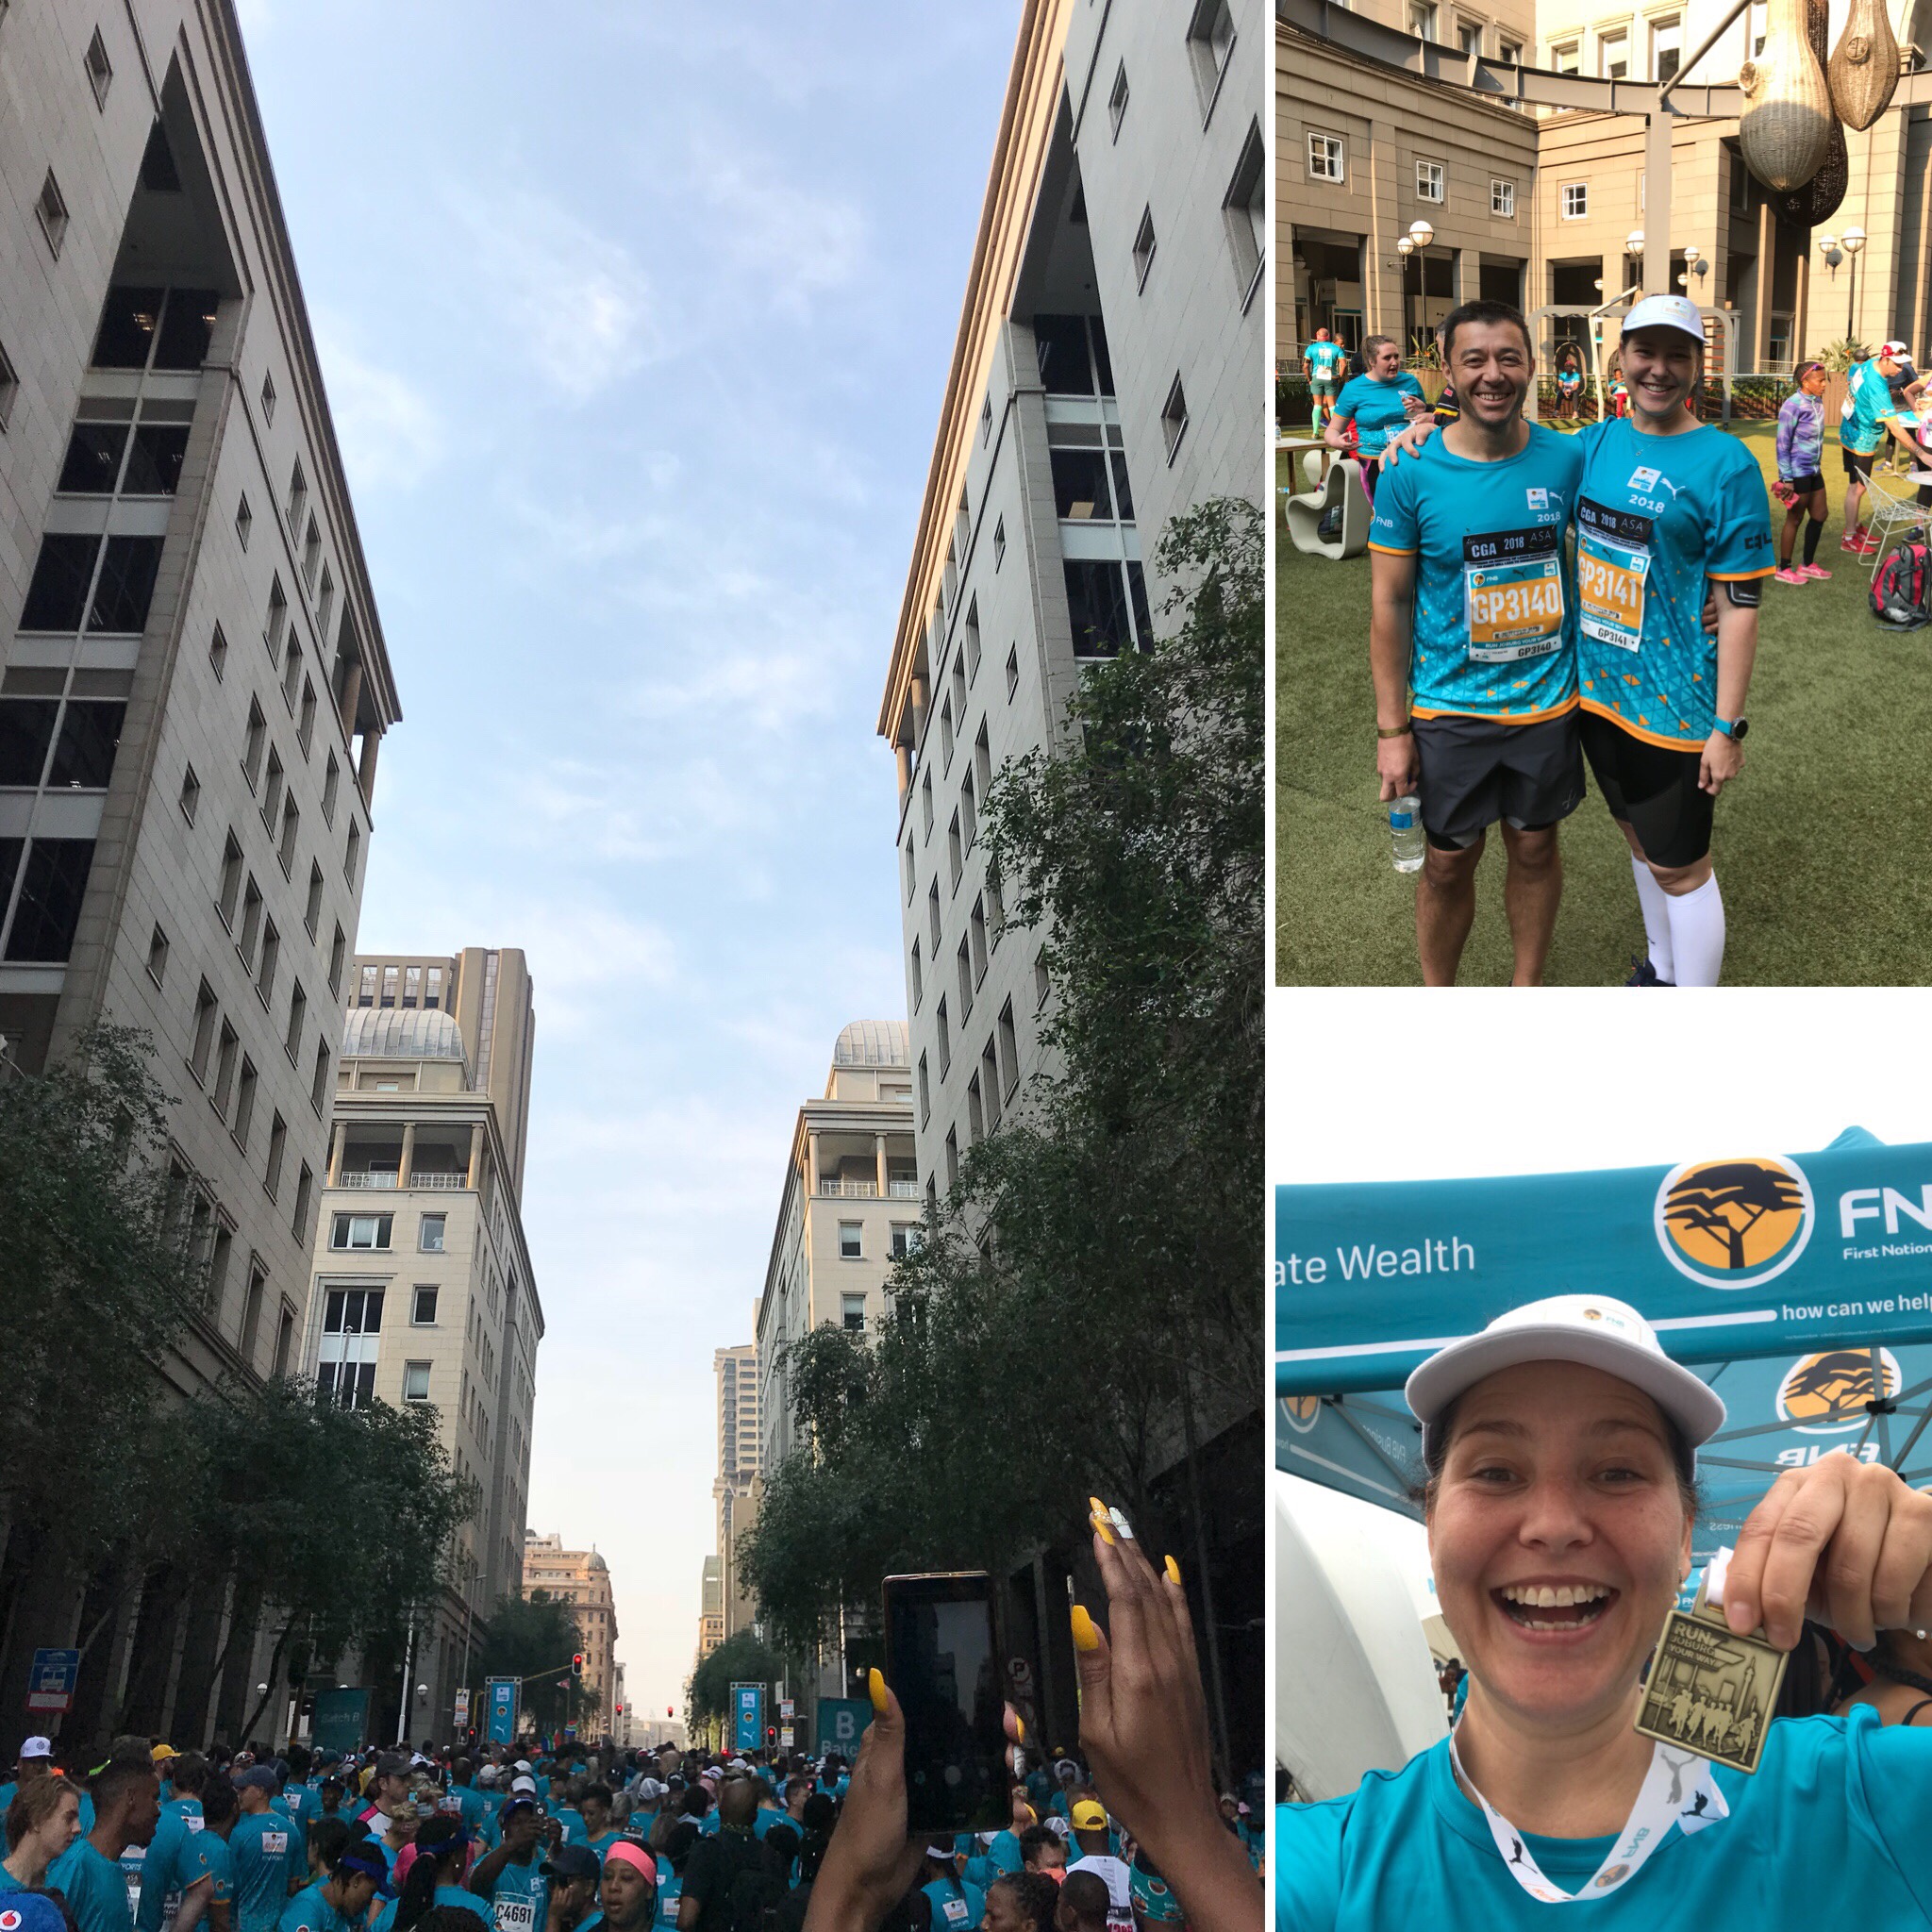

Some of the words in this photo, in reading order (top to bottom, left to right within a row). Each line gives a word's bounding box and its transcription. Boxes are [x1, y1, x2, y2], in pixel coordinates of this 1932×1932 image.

[1628, 493, 1665, 513] 2018
[1375, 516, 1393, 528] FNB
[1538, 512, 1561, 523] 2018
[1580, 507, 1596, 524] CGA
[1601, 513, 1616, 528] 2018
[1621, 518, 1643, 532] ASA
[1472, 542, 1497, 558] CGA
[1504, 537, 1524, 550] 2018
[1530, 530, 1552, 542] ASA
[1578, 556, 1637, 608] GP3141
[1473, 582, 1558, 625] GP3140
[1598, 627, 1627, 646] GP3141
[1518, 641, 1552, 658] GP3140
[1336, 1236, 1475, 1280] Wealth
[1843, 1247, 1879, 1260] First
[1882, 1242, 1932, 1257] Nation
[1782, 1304, 1824, 1321] how
[1827, 1302, 1863, 1317] can
[1867, 1298, 1894, 1314] we
[1898, 1291, 1932, 1312] hel
[1674, 1622, 1711, 1644] RUN
[1670, 1635, 1716, 1656] JOBURG
[1670, 1644, 1693, 1658] YOUR
[1697, 1653, 1717, 1666] WAY
[836, 1710, 855, 1739] B
[821, 1740, 860, 1757] Batc
[496, 1904, 532, 1924] C4681
